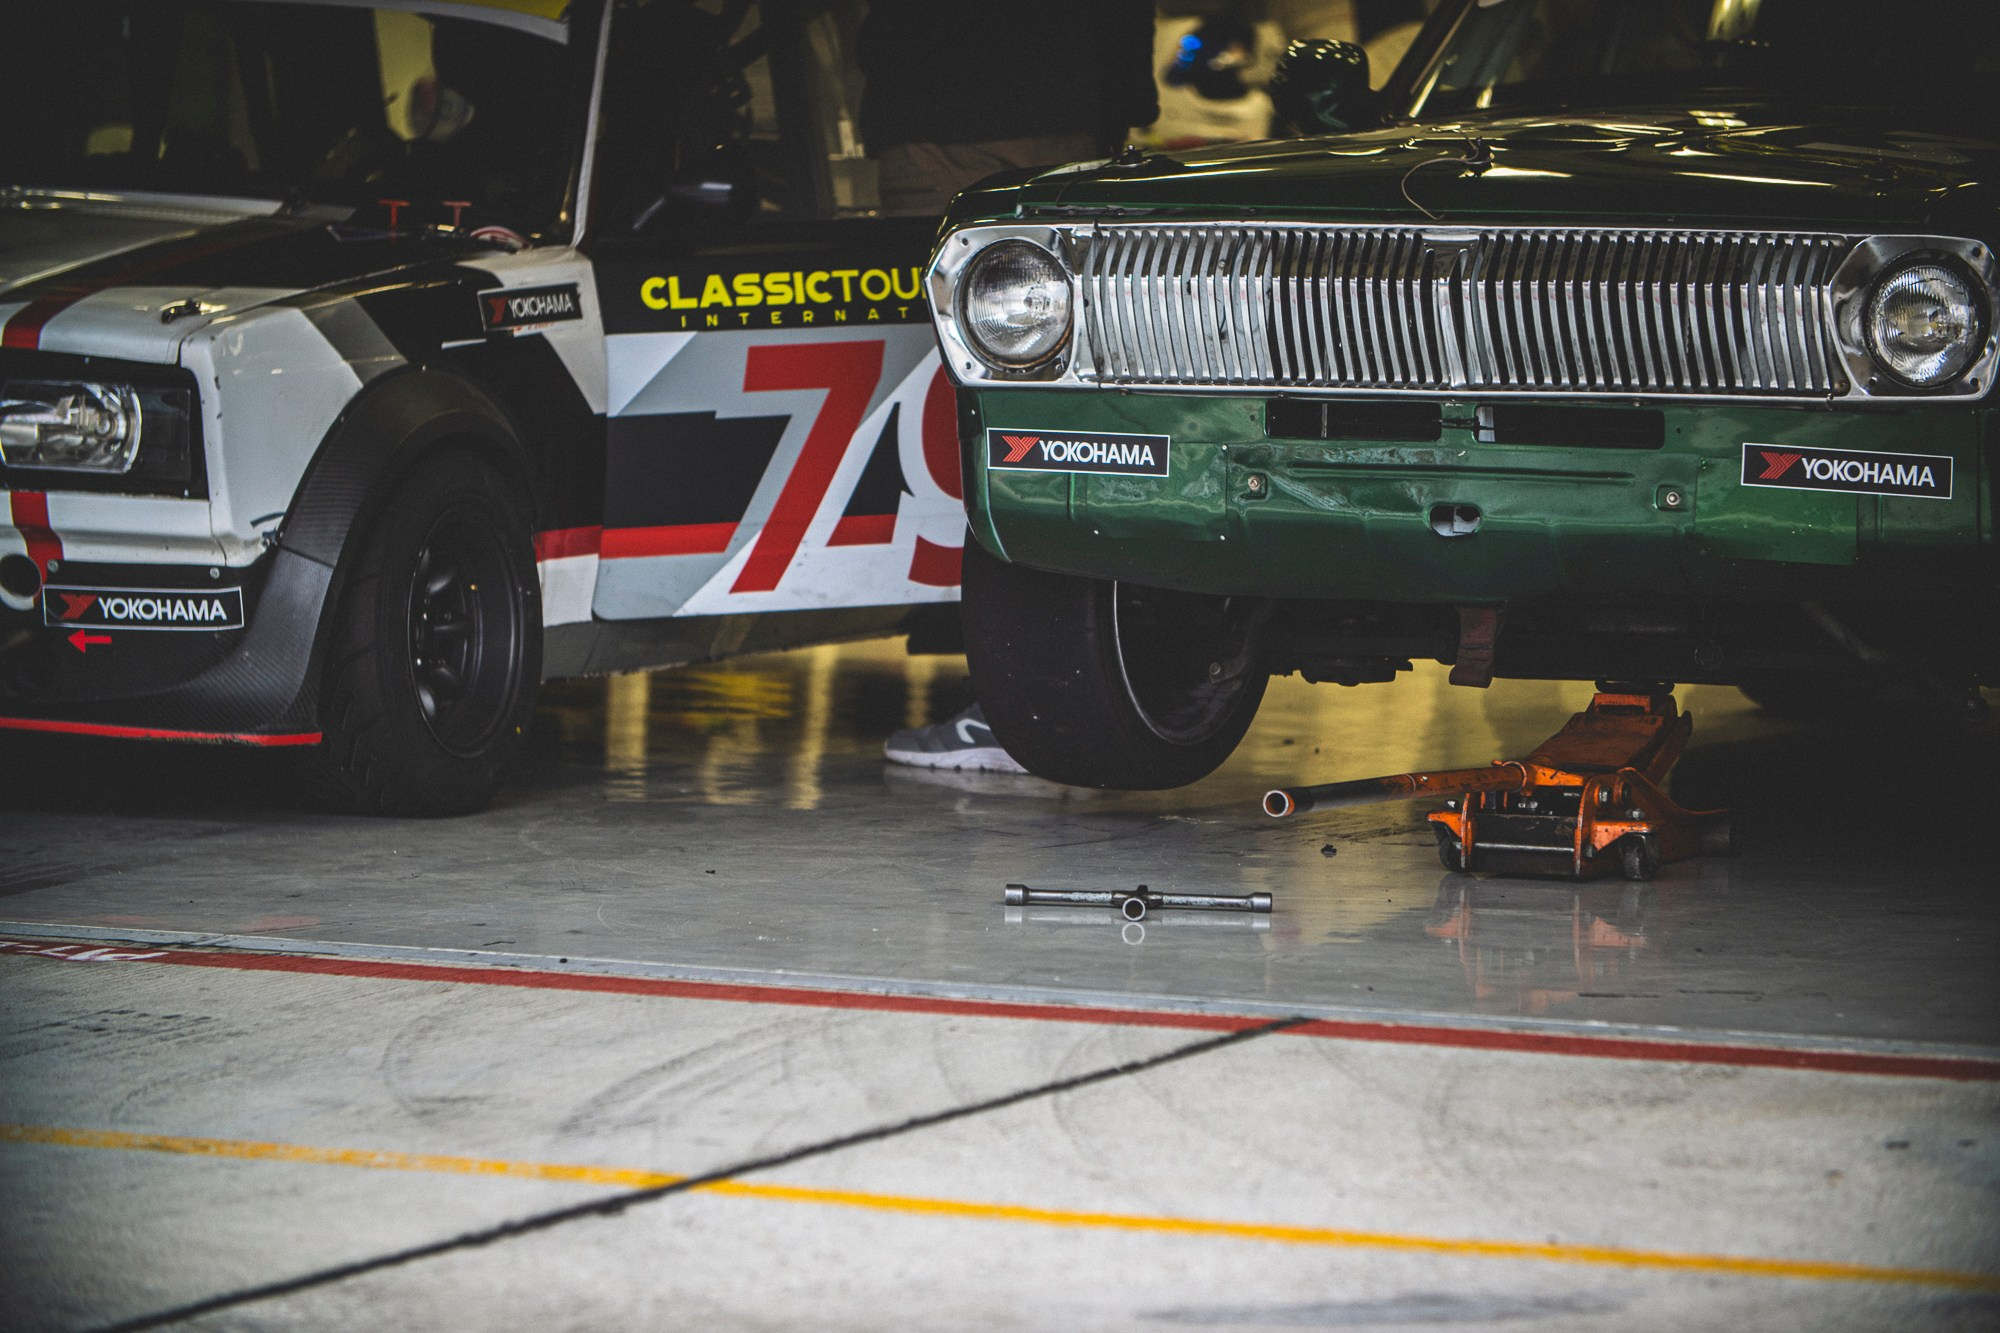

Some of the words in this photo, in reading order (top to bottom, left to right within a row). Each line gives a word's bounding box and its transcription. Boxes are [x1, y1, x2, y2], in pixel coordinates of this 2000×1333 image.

[640, 266, 927, 311] CLASSICTOU
[507, 292, 575, 319] YOKOHAMA
[681, 306, 909, 328] INTERNAT
[1039, 440, 1155, 467] YOKOHAMA
[1801, 457, 1936, 488] YOKOHAMA
[98, 597, 228, 622] YOKOHAMA
